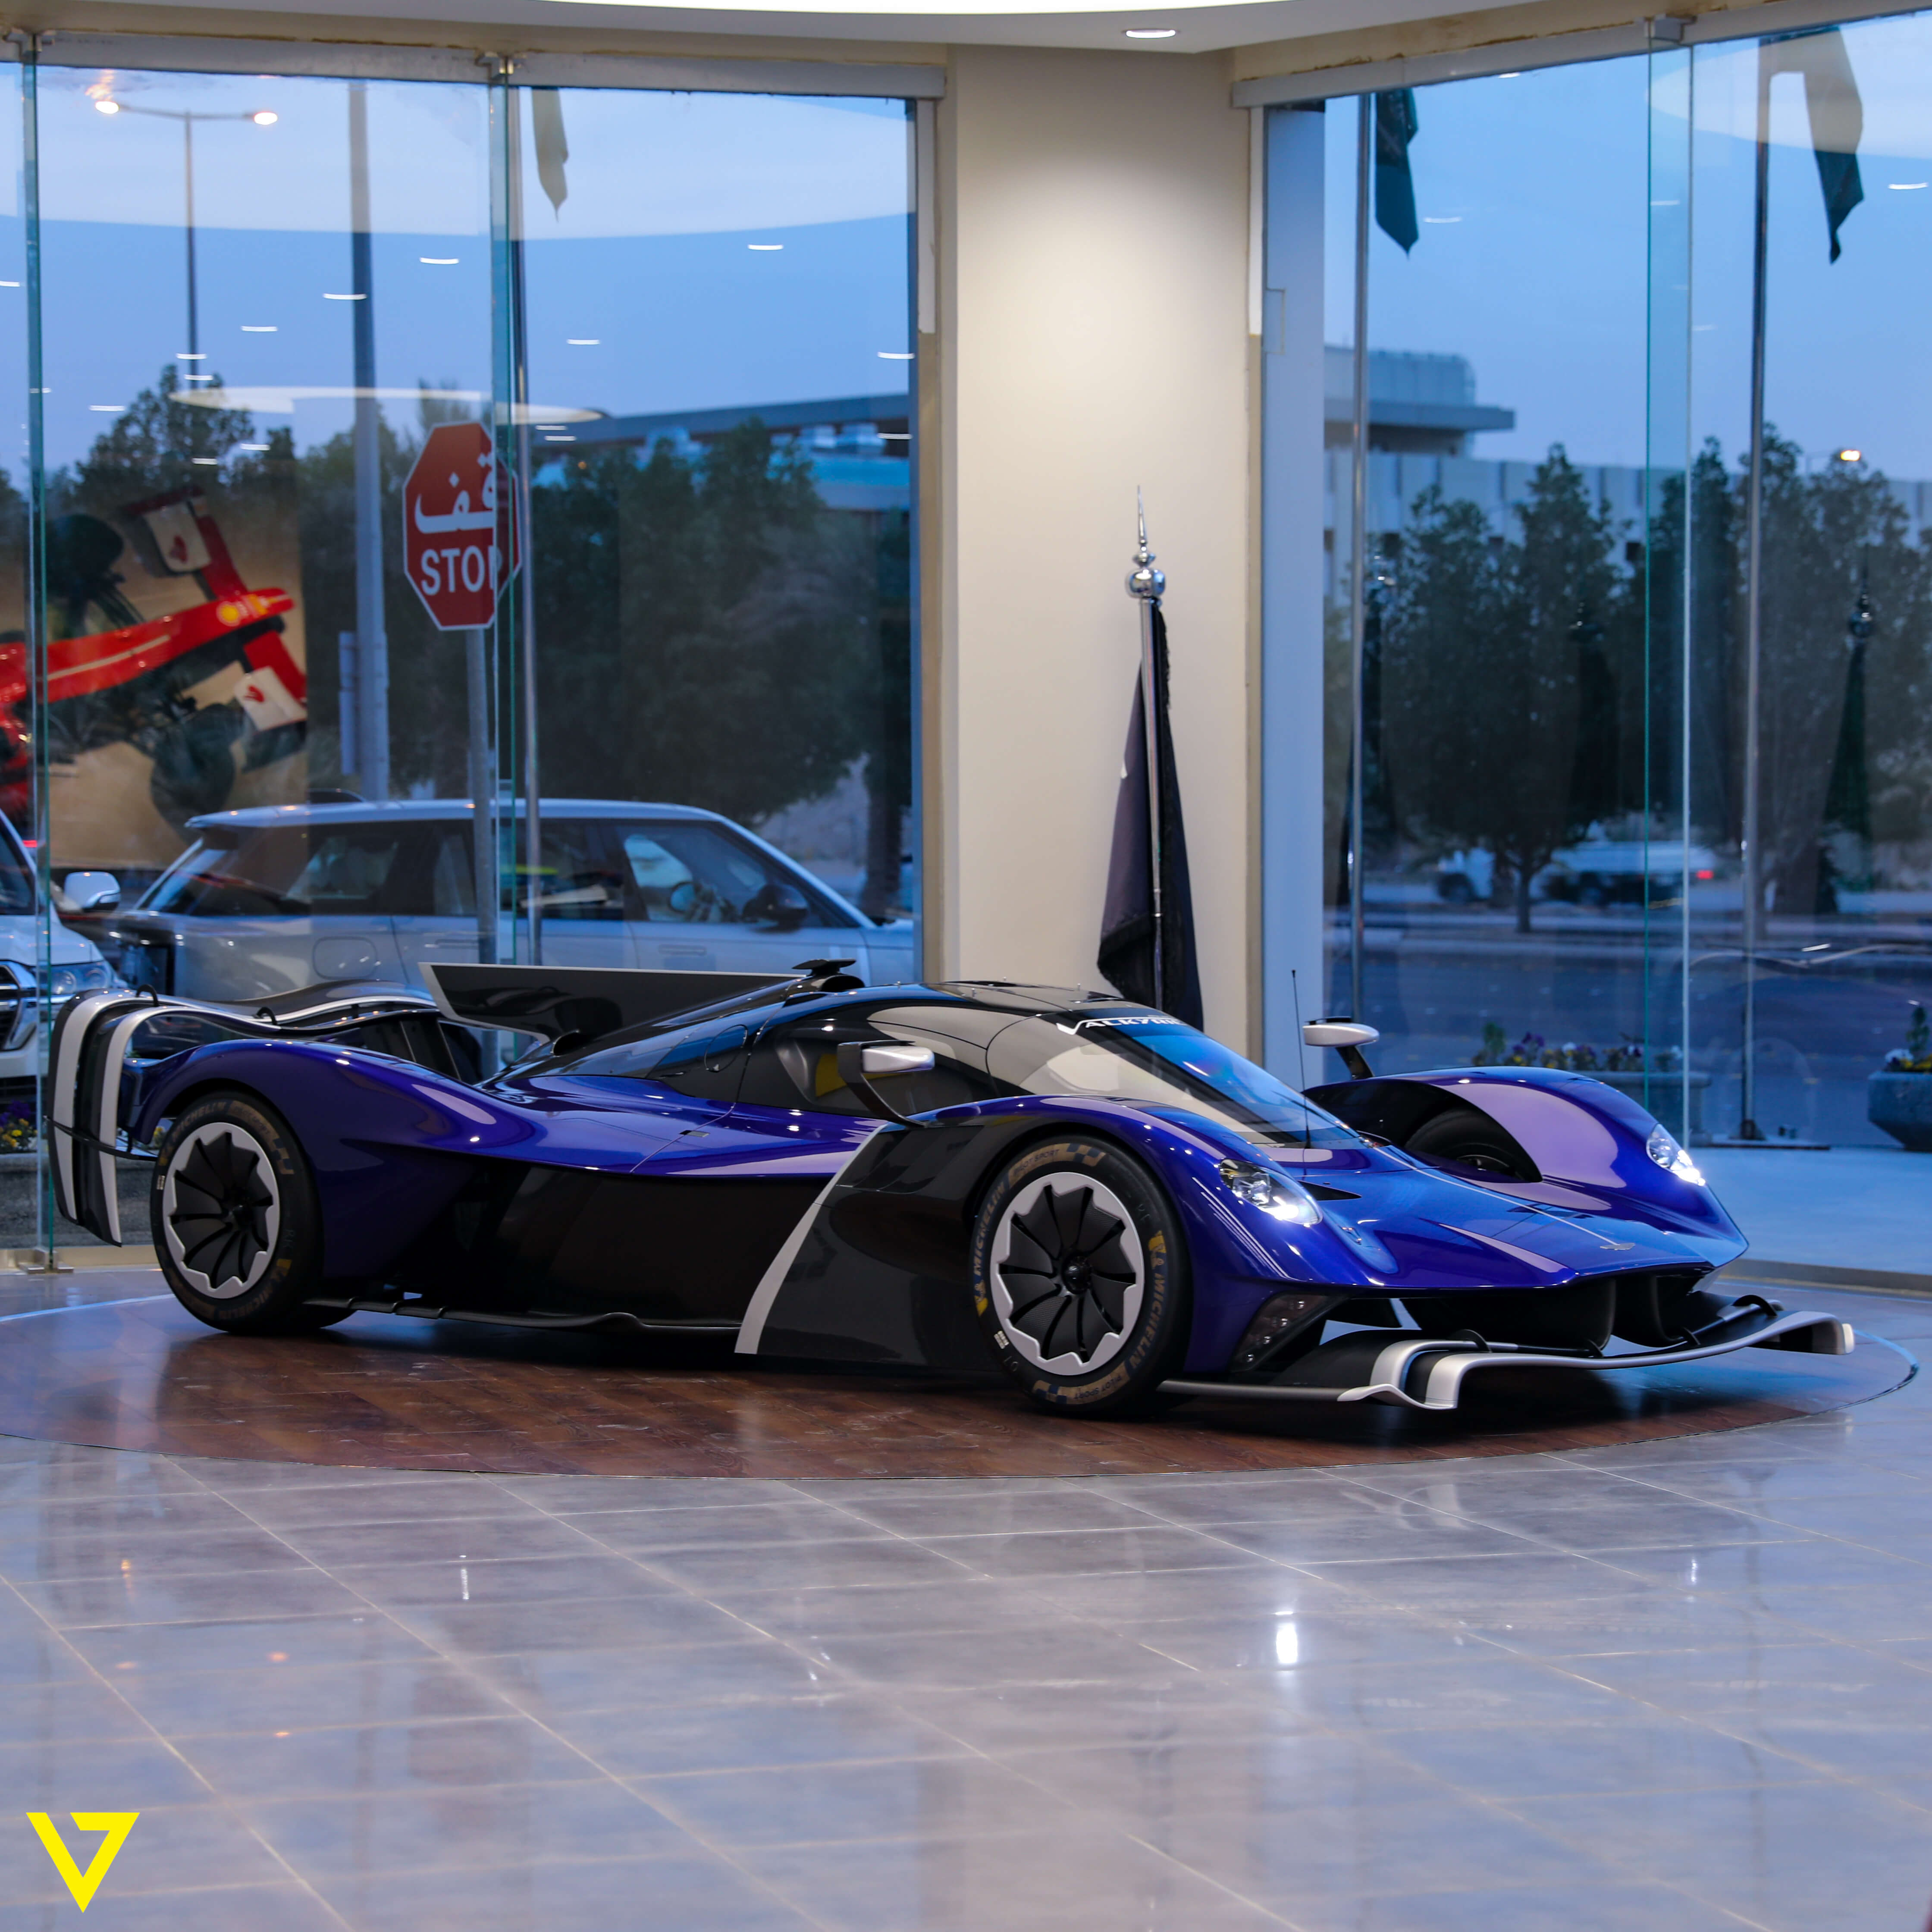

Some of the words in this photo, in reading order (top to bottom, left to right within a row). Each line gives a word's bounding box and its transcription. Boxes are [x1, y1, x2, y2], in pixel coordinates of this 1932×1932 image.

[421, 545, 502, 595] STOP
[973, 1182, 1004, 1276] MICHELIN
[1129, 1273, 1165, 1369] MICHELIN
